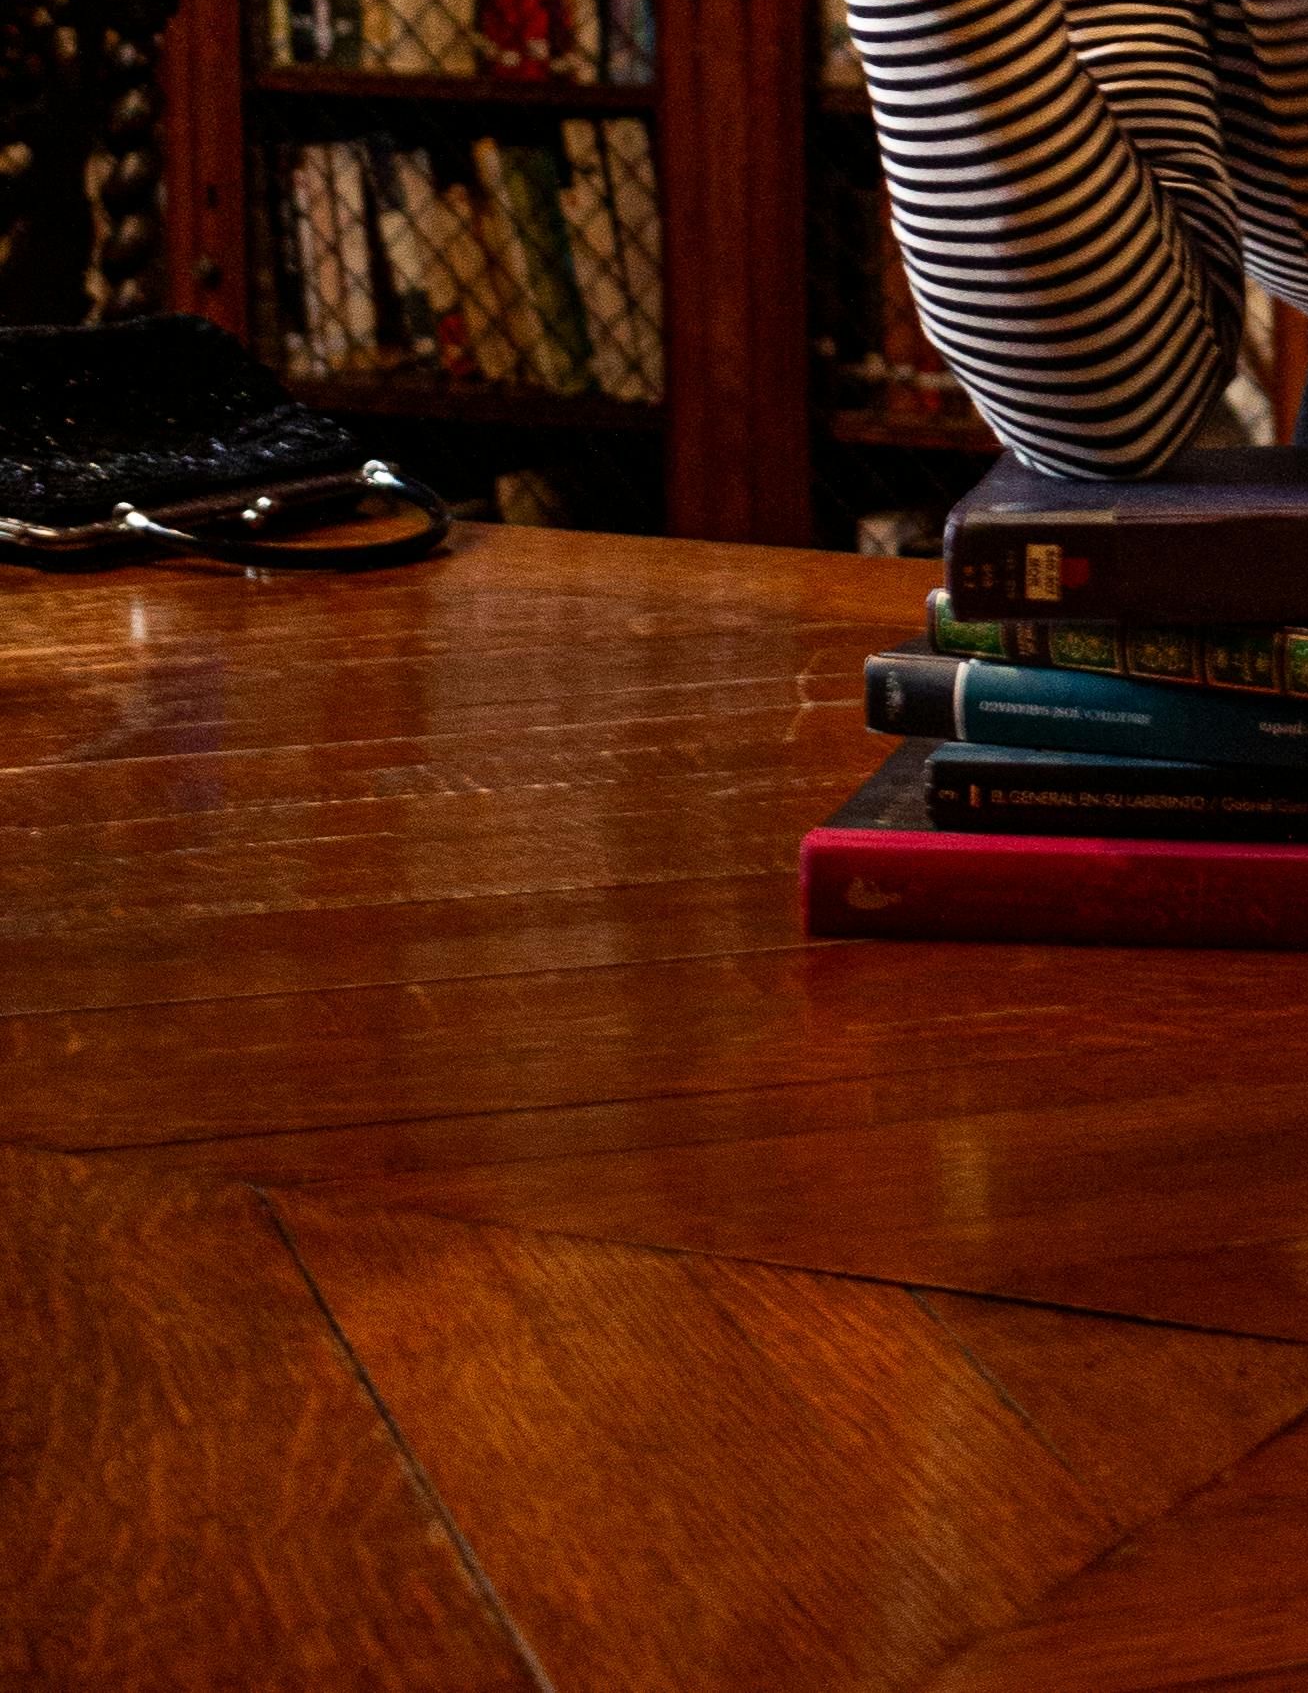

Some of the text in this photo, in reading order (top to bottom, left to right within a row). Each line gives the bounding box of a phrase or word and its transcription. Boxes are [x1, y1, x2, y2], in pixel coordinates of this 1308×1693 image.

[979, 700, 1050, 716] SARAMAGO
[990, 789, 1006, 804] EL
[1009, 790, 1077, 806] GENERAL
[1079, 792, 1100, 807] EN
[1103, 793, 1123, 808] SU
[1126, 794, 1205, 810] LABERINTO
[1222, 796, 1272, 812] Gabriel
